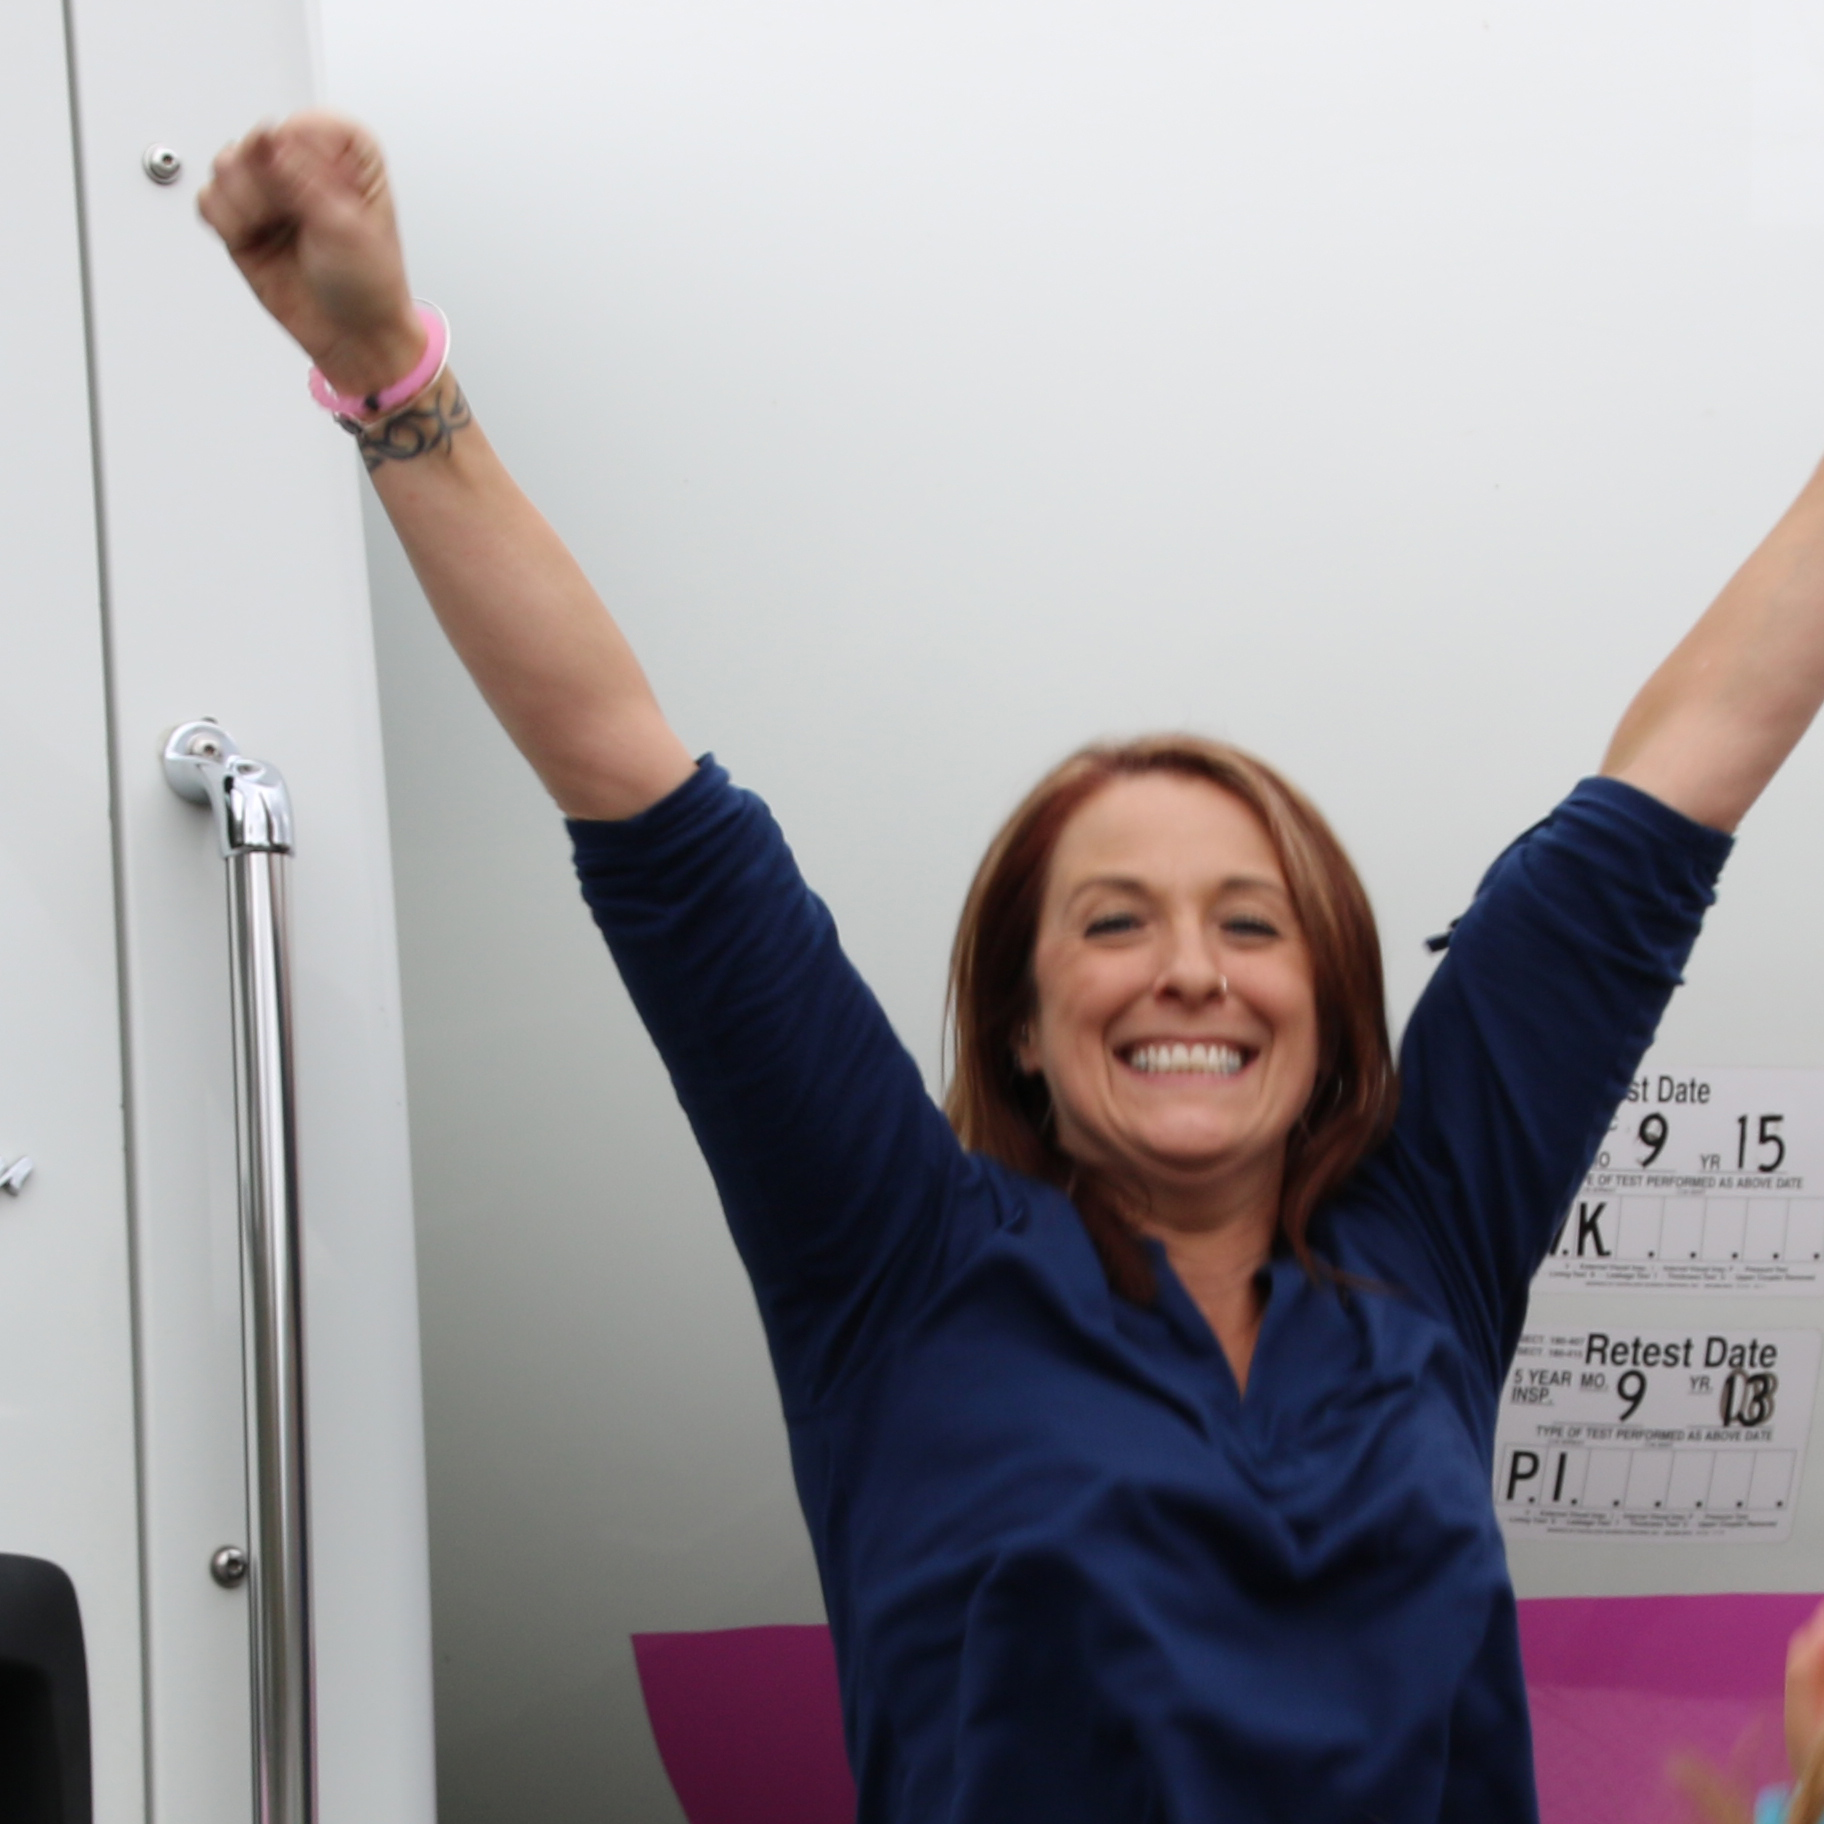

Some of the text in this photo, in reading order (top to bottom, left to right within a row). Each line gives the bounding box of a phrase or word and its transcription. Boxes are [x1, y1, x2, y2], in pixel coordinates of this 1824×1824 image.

[1658, 1075, 1712, 1105] Date
[1637, 1111, 1670, 1168] 9
[1700, 1153, 1721, 1171] YR
[1737, 1114, 1788, 1173] 15
[1598, 1174, 1614, 1187] OF
[1615, 1175, 1643, 1188] TEST
[1647, 1175, 1716, 1189] PERFORMED
[1719, 1177, 1734, 1189] AS
[1737, 1177, 1773, 1190] ABOVE
[1776, 1177, 1804, 1190] DATE
[1585, 1333, 1778, 1369] Retest Date
[1514, 1369, 1572, 1386] 5 YEAR
[1617, 1370, 1648, 1422] 9
[1536, 1425, 1773, 1442] TYPE OF TEST PERFORMED AS ABOVE DATE
